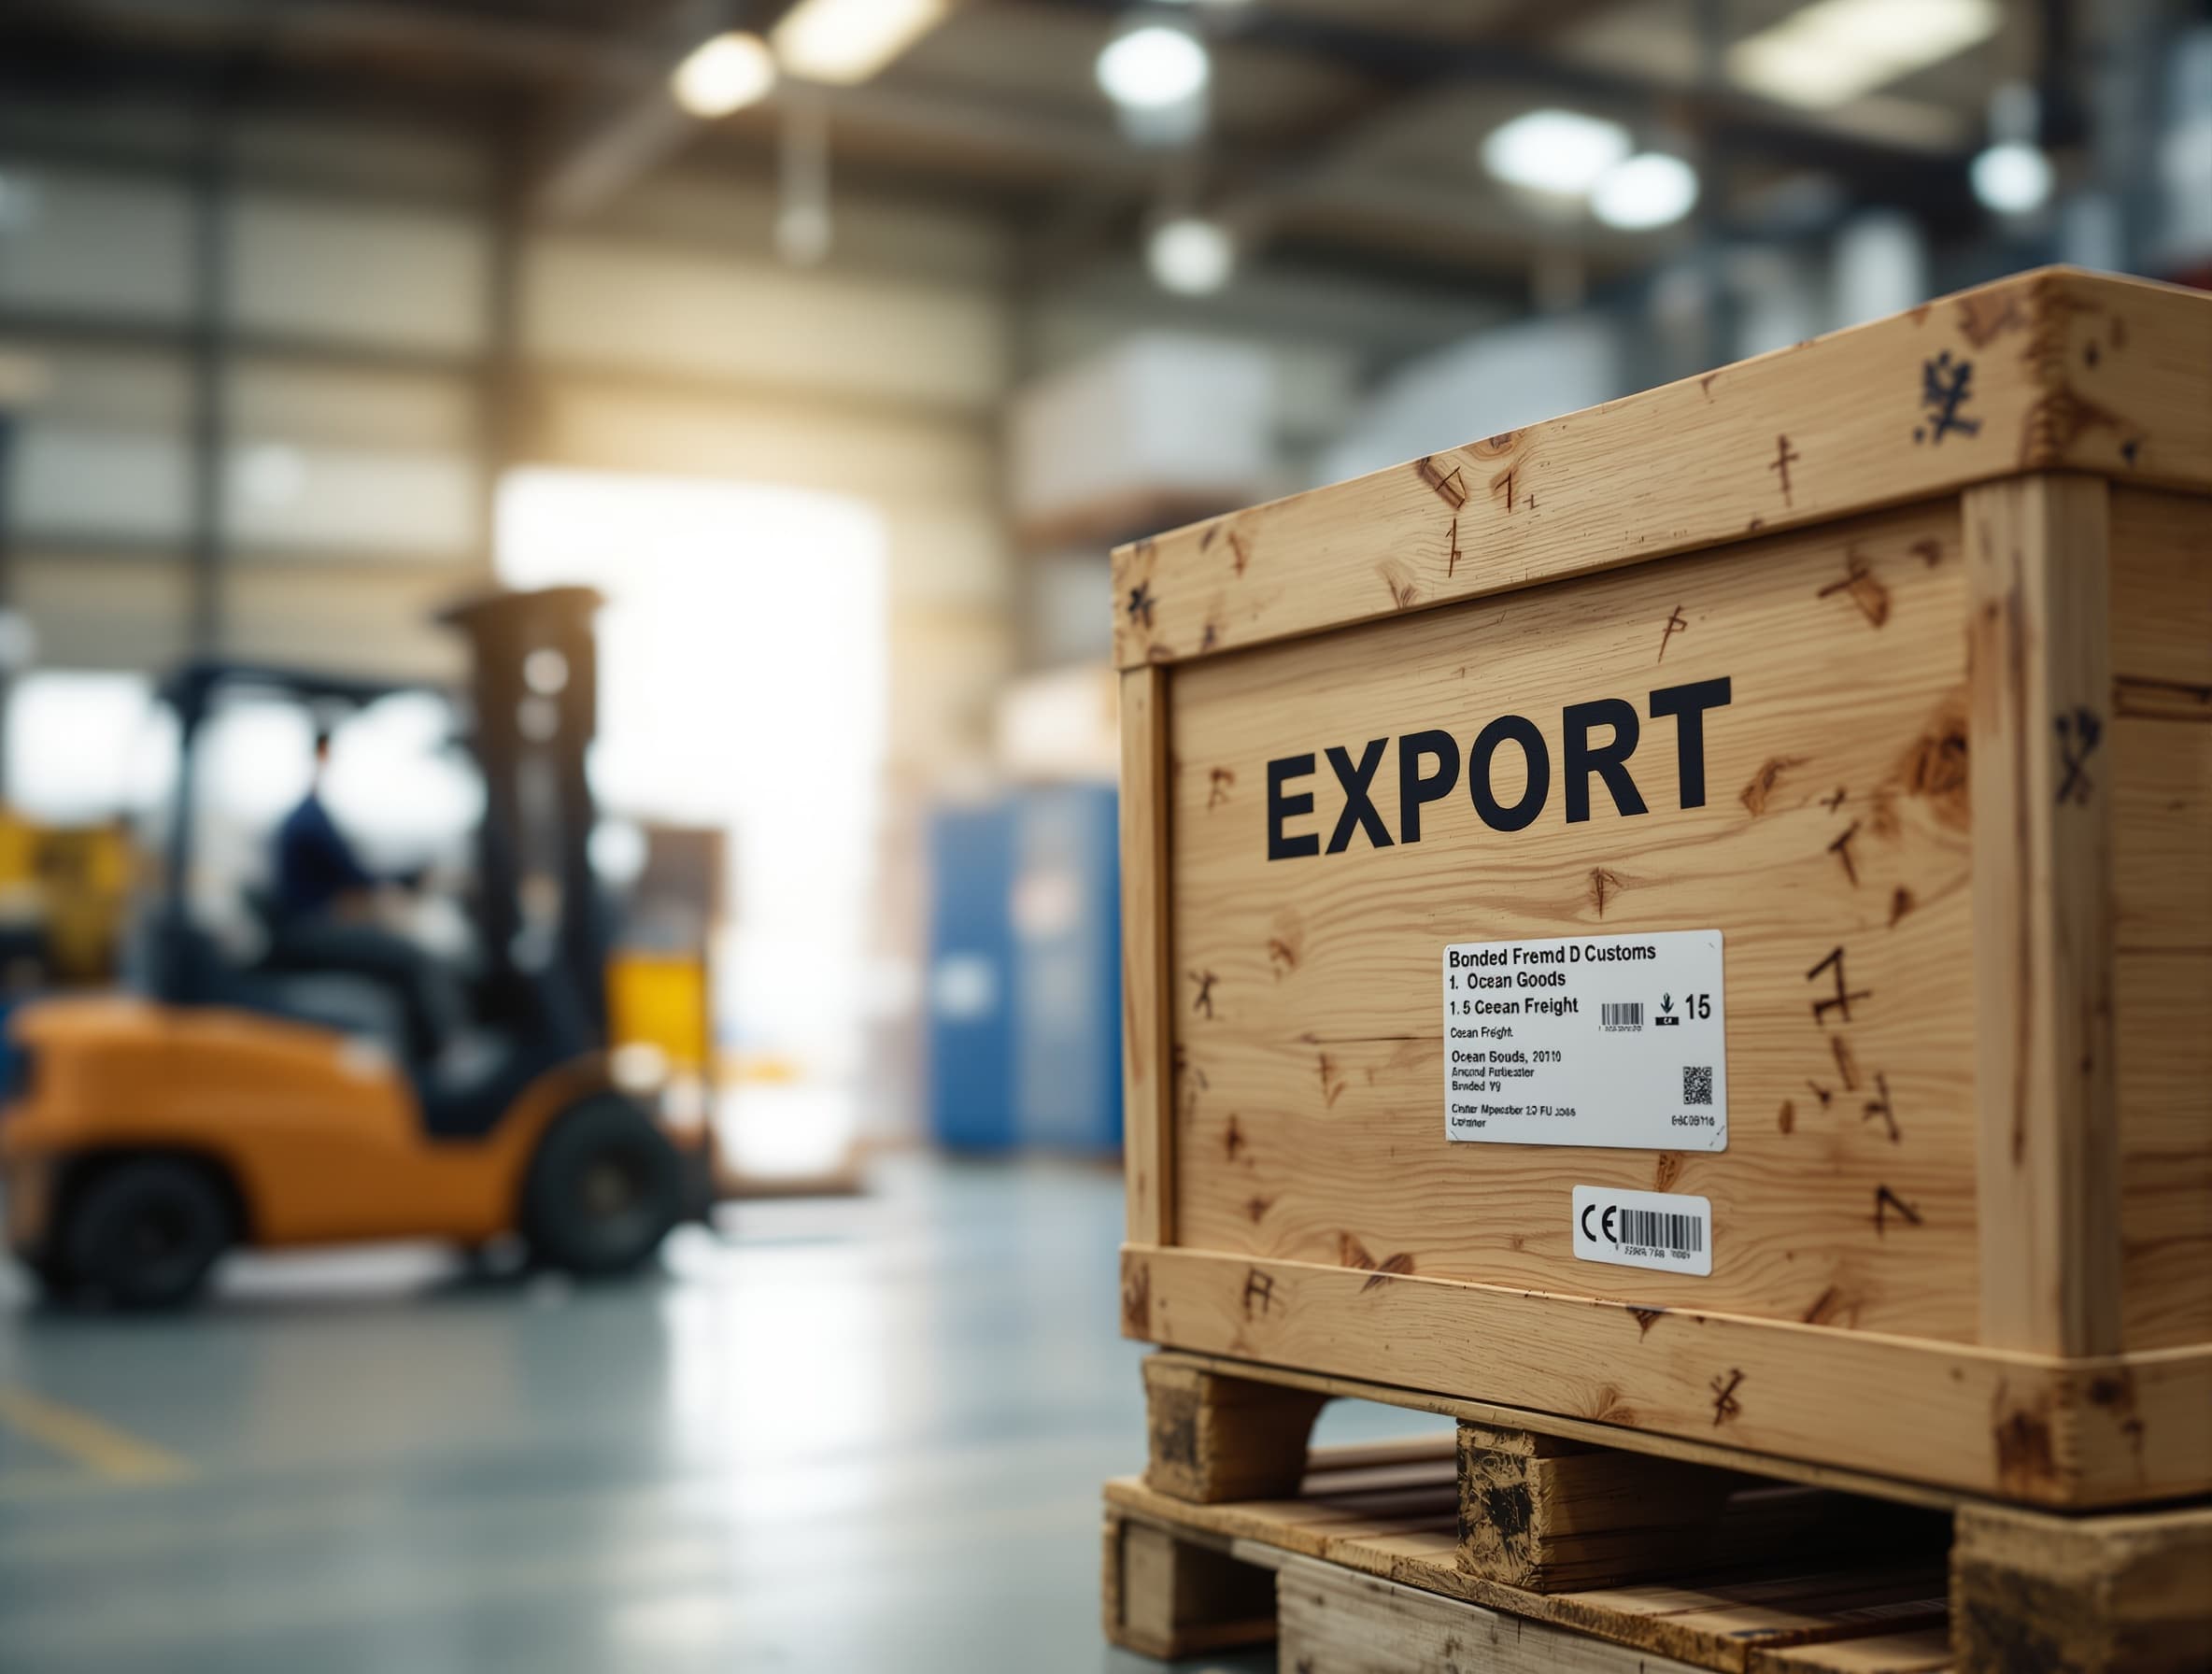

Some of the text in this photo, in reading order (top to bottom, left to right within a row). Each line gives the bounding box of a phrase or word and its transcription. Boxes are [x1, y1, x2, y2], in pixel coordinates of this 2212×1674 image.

[1267, 675, 1732, 861] EXPORT
[1449, 944, 1656, 968] Bonded Fremd D Customs
[1467, 972, 1511, 989] Ocean
[1517, 971, 1566, 987] Goods
[1524, 997, 1579, 1016] Freight
[1685, 994, 1711, 1020] 15
[1581, 1204, 1617, 1243] CE
